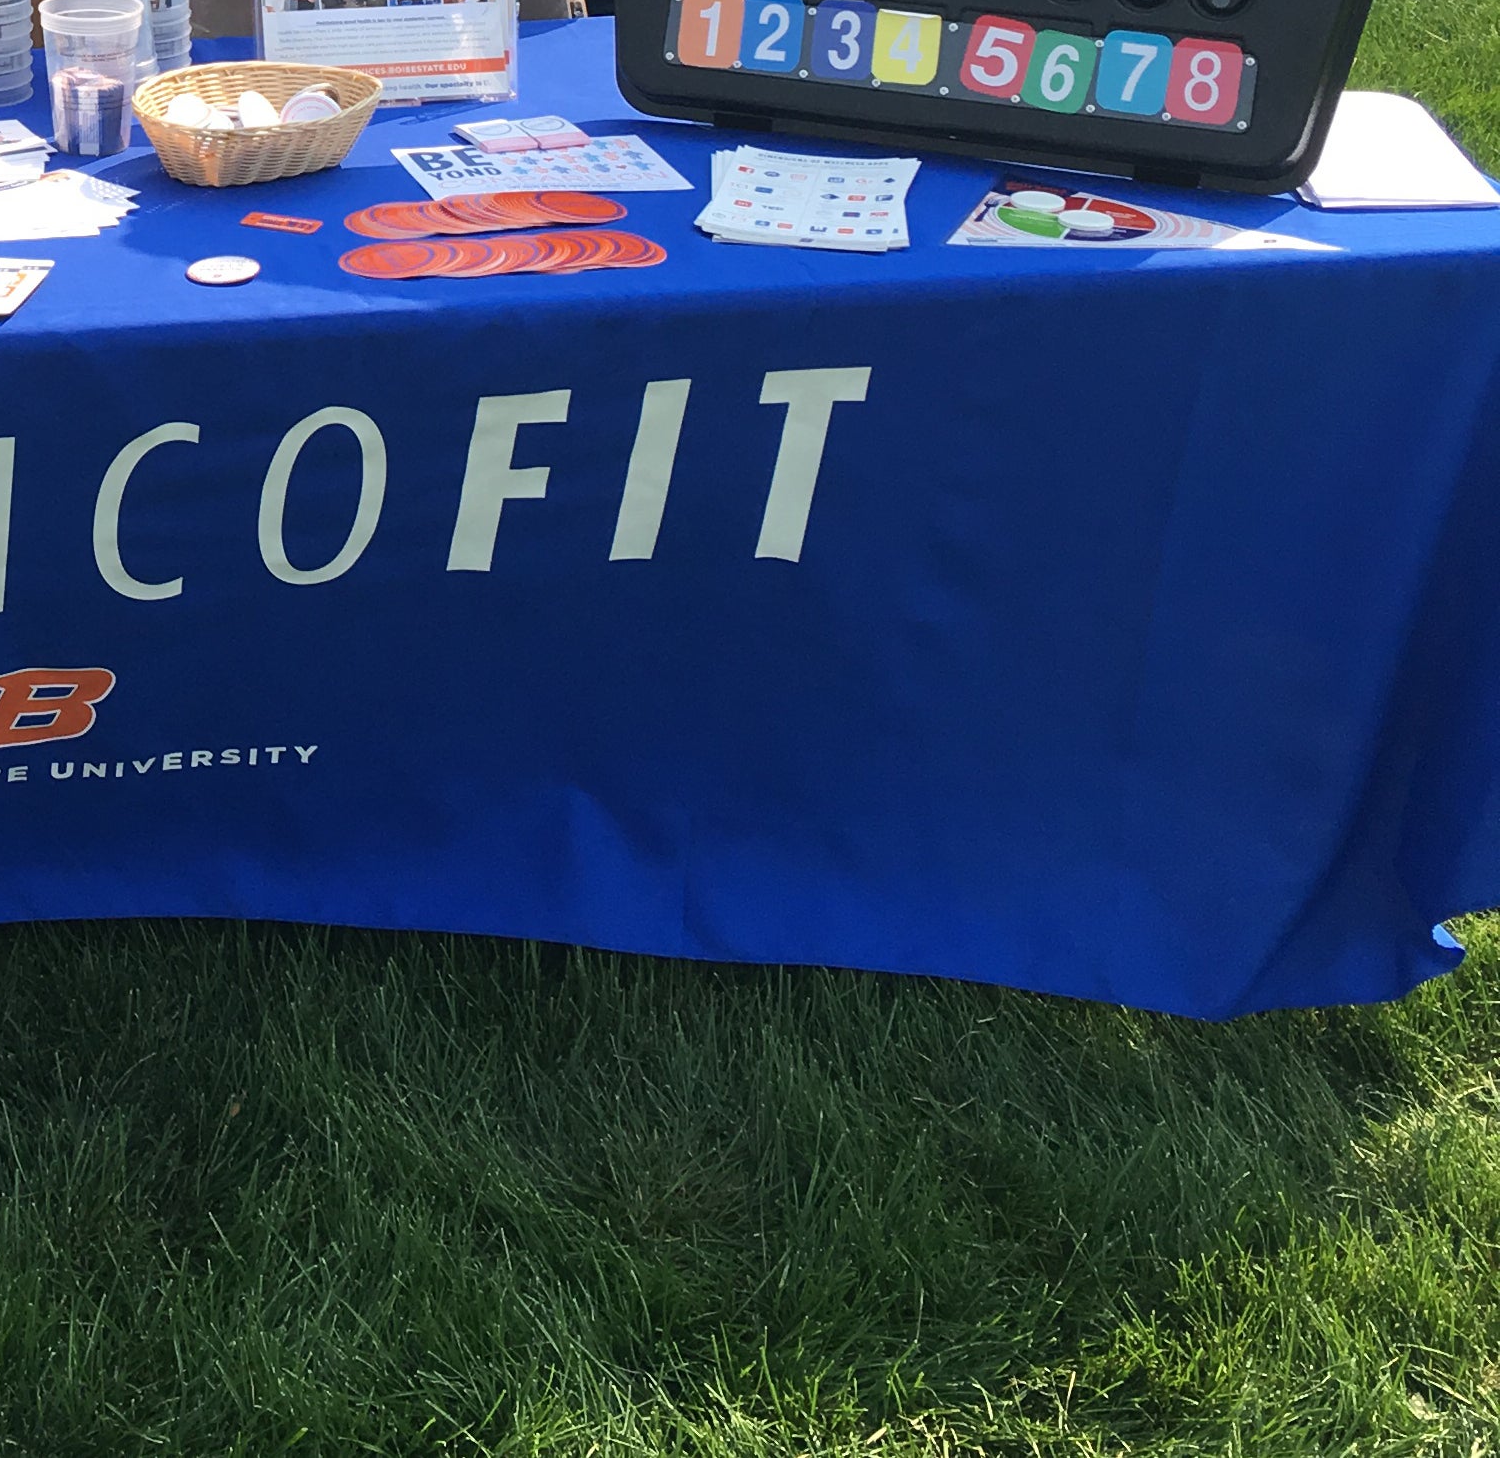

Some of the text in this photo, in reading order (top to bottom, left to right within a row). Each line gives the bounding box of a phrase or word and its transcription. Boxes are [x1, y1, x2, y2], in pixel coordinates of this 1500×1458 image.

[700, 1, 1223, 112] 1 2 3 4 5 6 7 8
[408, 147, 495, 172] BE
[428, 166, 502, 182] YOND
[50, 745, 319, 780] UNIVERSITY
